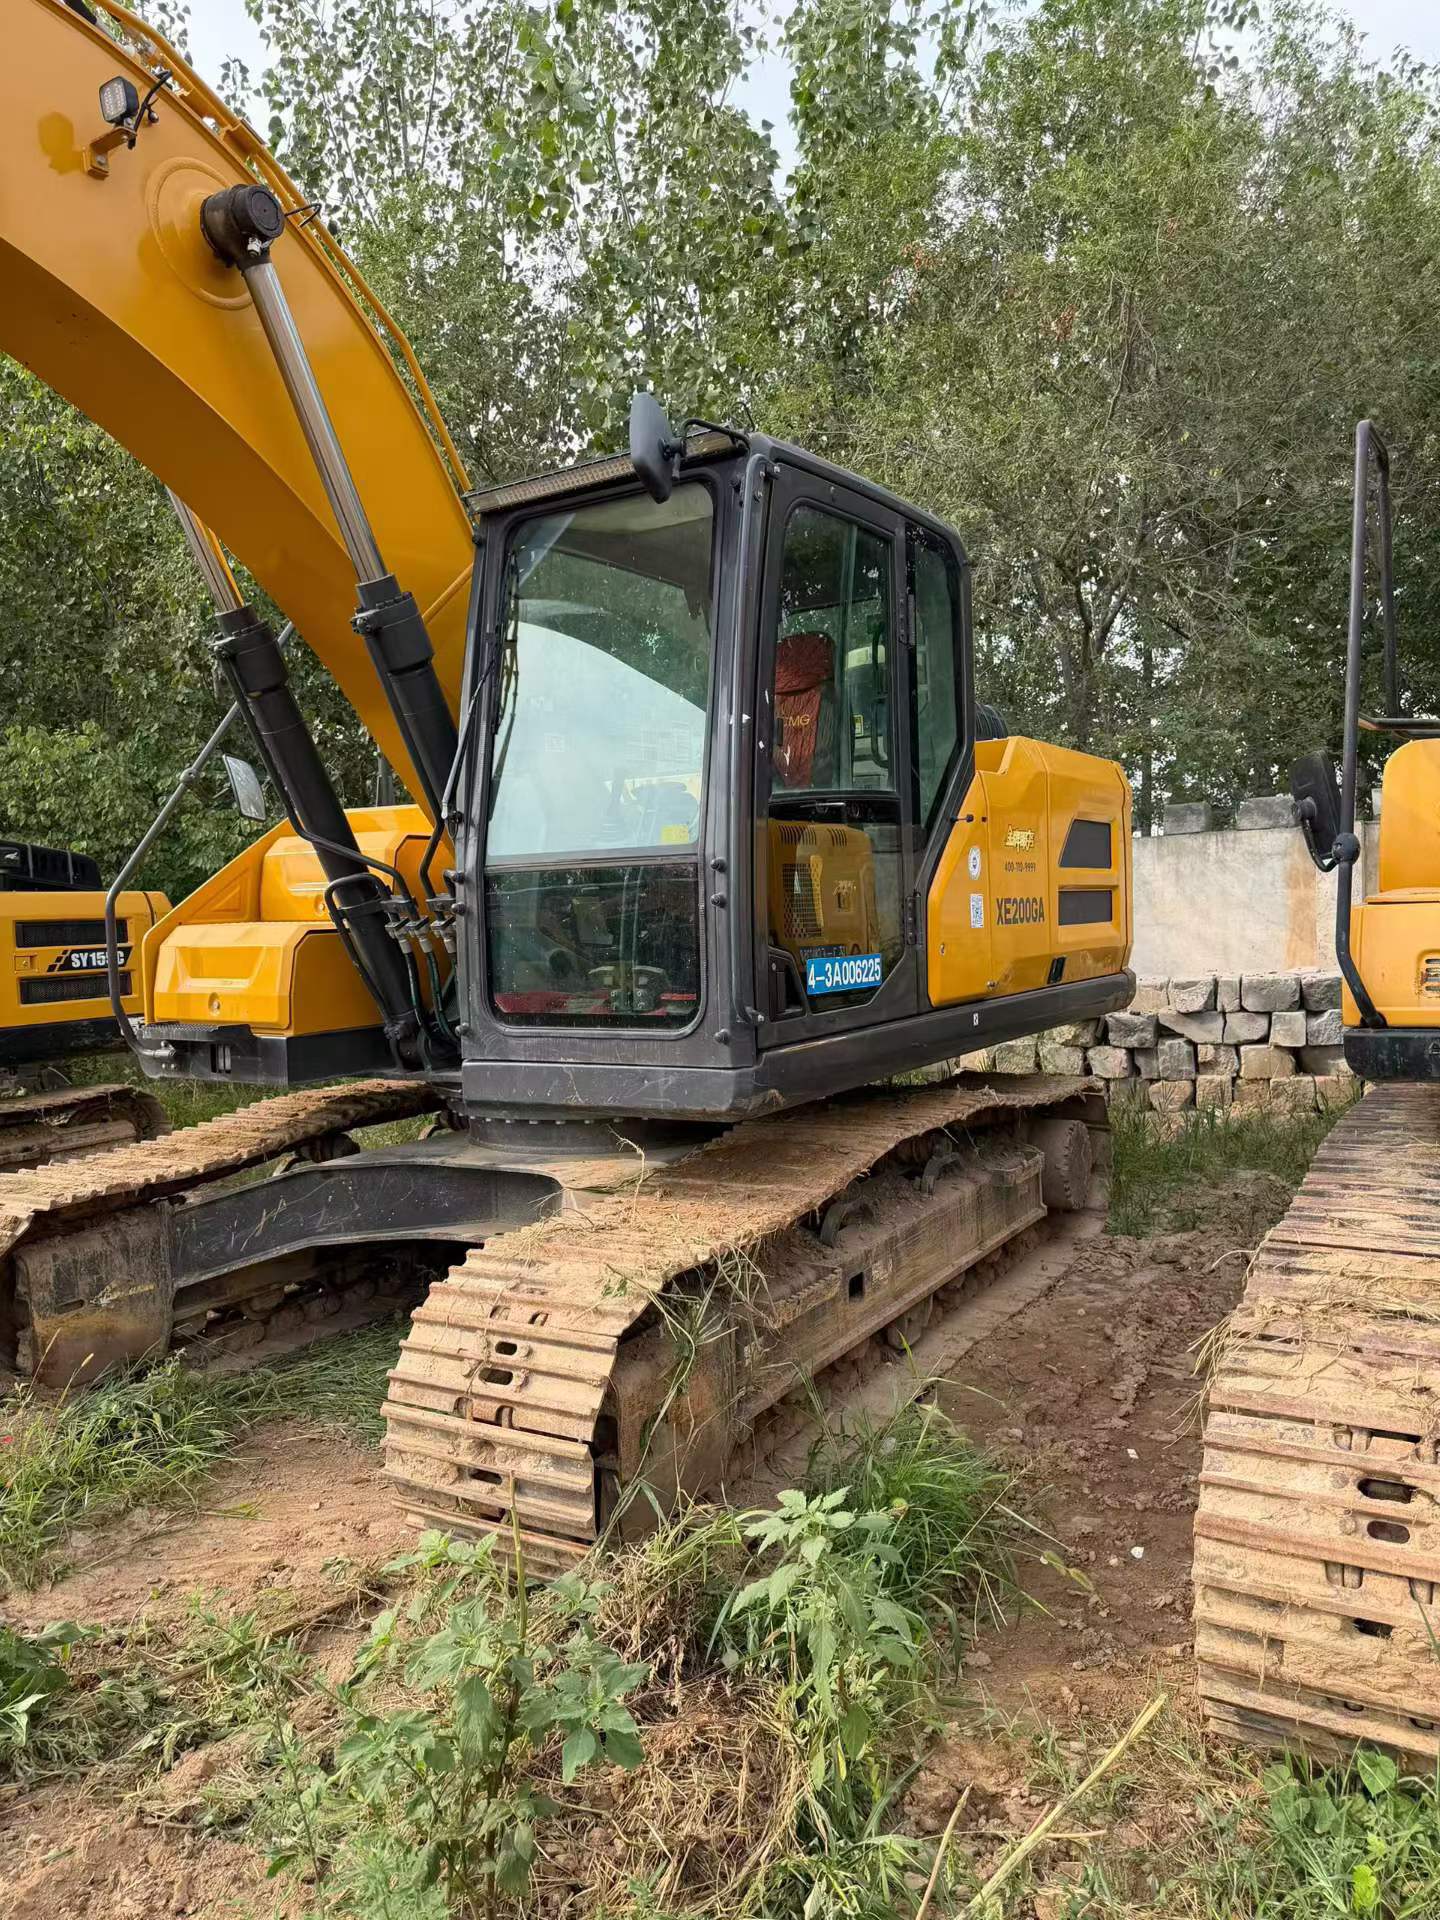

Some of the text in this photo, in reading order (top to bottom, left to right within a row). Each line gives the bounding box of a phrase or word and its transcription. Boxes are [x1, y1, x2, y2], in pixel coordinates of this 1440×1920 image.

[996, 897, 1045, 925] XE200GA
[71, 950, 125, 968] SY15C
[808, 958, 881, 989] 4-3A006225
